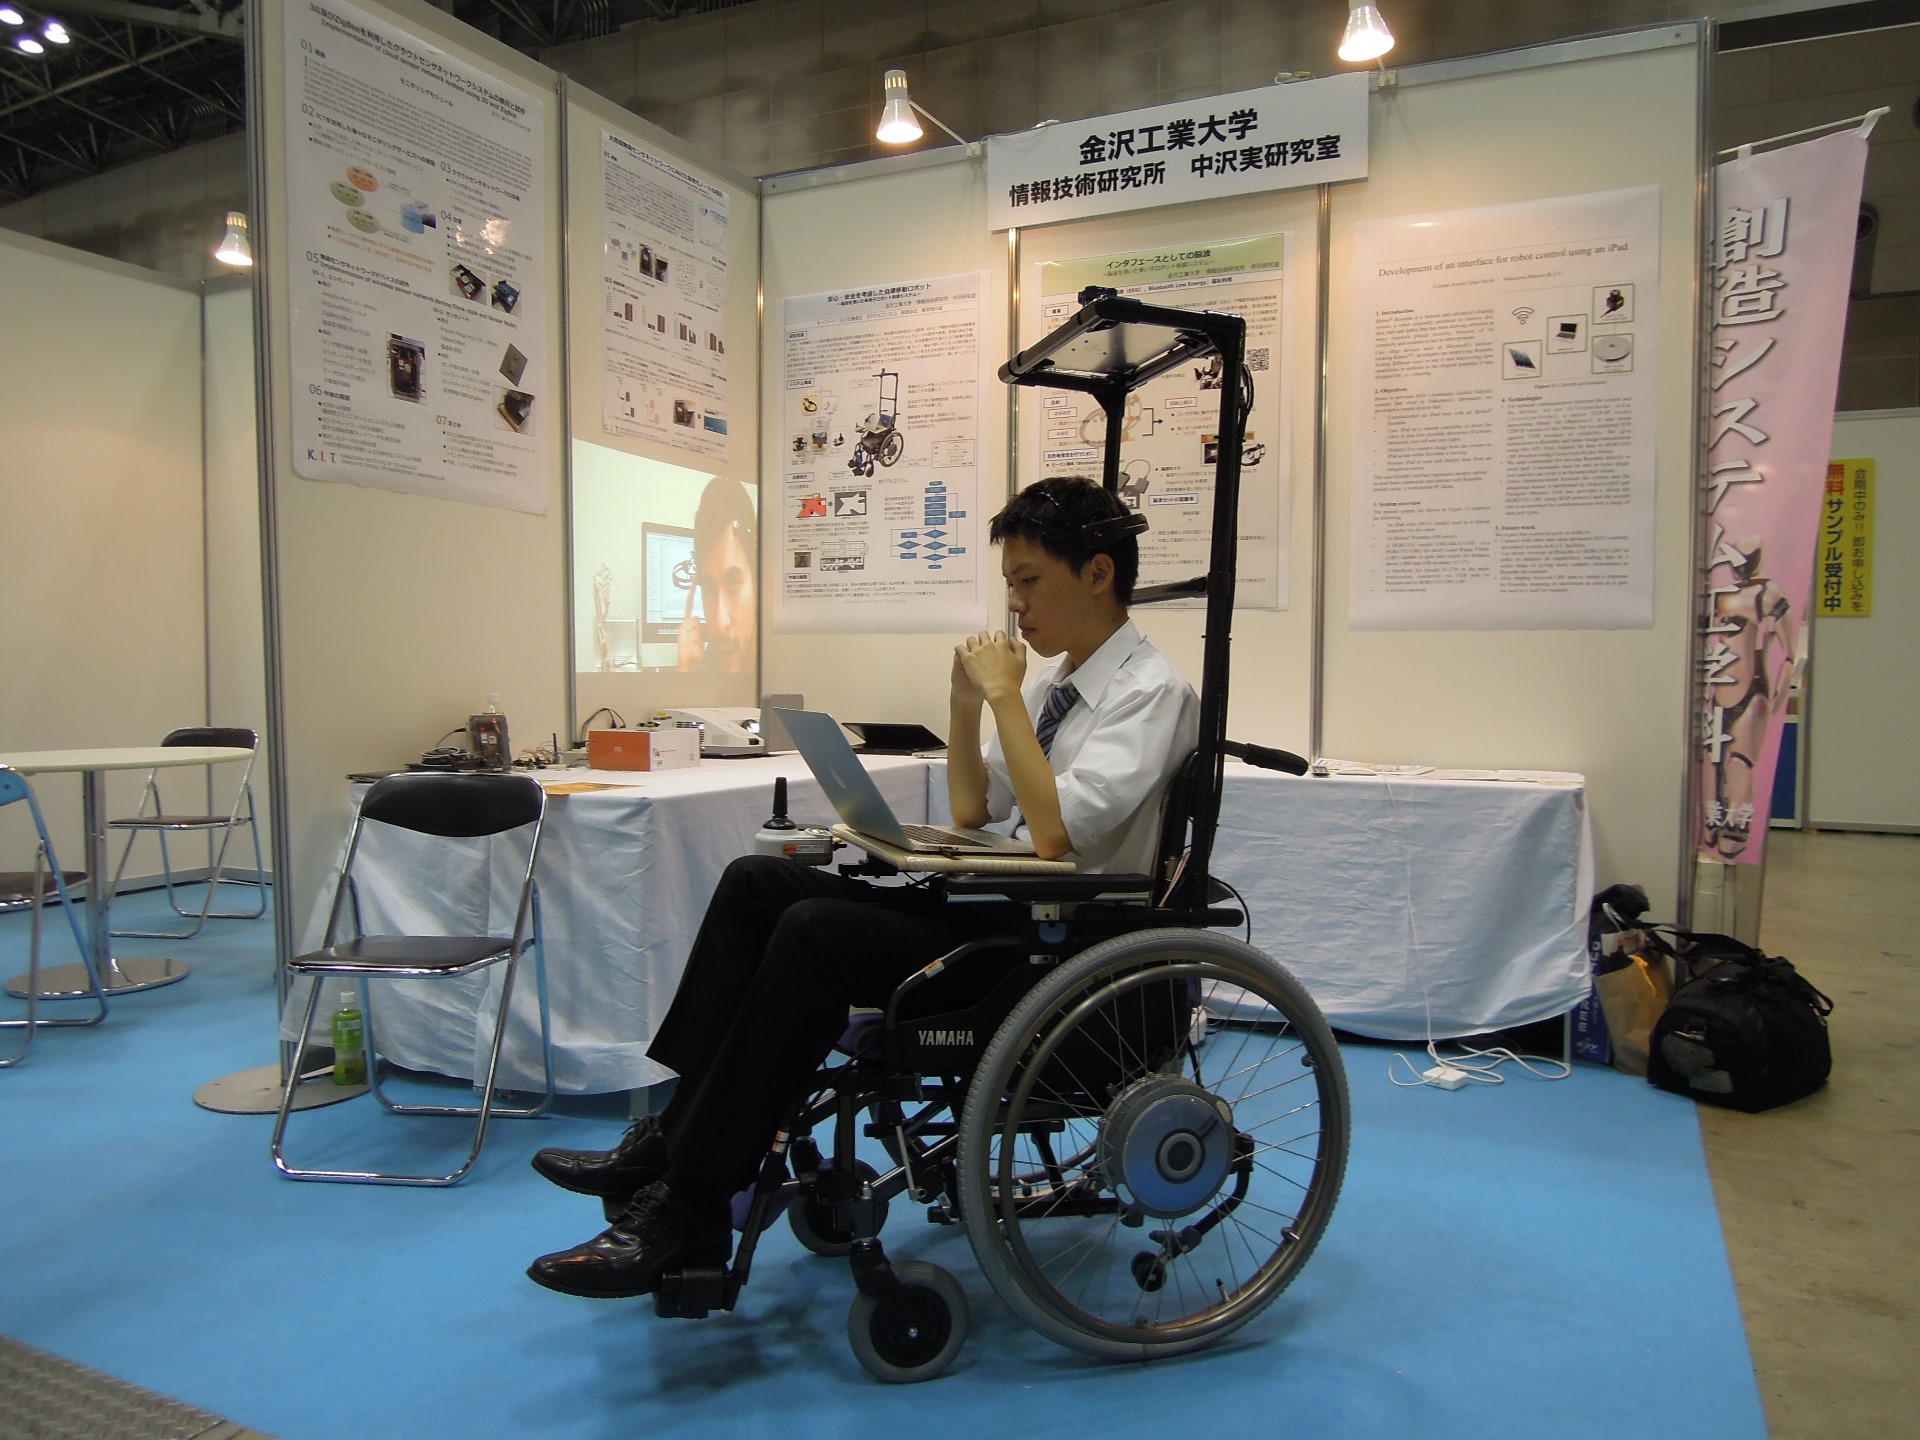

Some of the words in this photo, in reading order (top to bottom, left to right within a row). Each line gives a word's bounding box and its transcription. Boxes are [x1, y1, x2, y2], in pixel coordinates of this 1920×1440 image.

[300, 39, 313, 53] 01
[301, 103, 314, 117] 02
[1079, 107, 1259, 166] 金沢工業大学
[440, 161, 451, 174] 03
[1009, 160, 1166, 208] 情報技術研究所
[1191, 134, 1341, 180] 中沢実研究室
[440, 210, 452, 222] 04
[306, 250, 319, 264] 05
[1106, 249, 1212, 269] インタフェースとしての脳波
[1379, 264, 1433, 277] Development
[1433, 262, 1444, 270] of
[1444, 262, 1455, 270] an
[1457, 257, 1494, 268] interface
[1495, 255, 1509, 264] for
[1510, 253, 1533, 262] robot
[1535, 249, 1566, 260] control
[1568, 248, 1593, 258] using
[1594, 246, 1606, 254] an
[1608, 242, 1629, 253] iPad
[827, 282, 932, 303] 安心・安全を考慮した自律移動ロボット
[1381, 308, 1414, 316] Introduction
[309, 383, 323, 396] 06
[1380, 387, 1408, 395] Objectives
[436, 414, 448, 426] 07
[918, 1030, 974, 1046] YAMAHA
